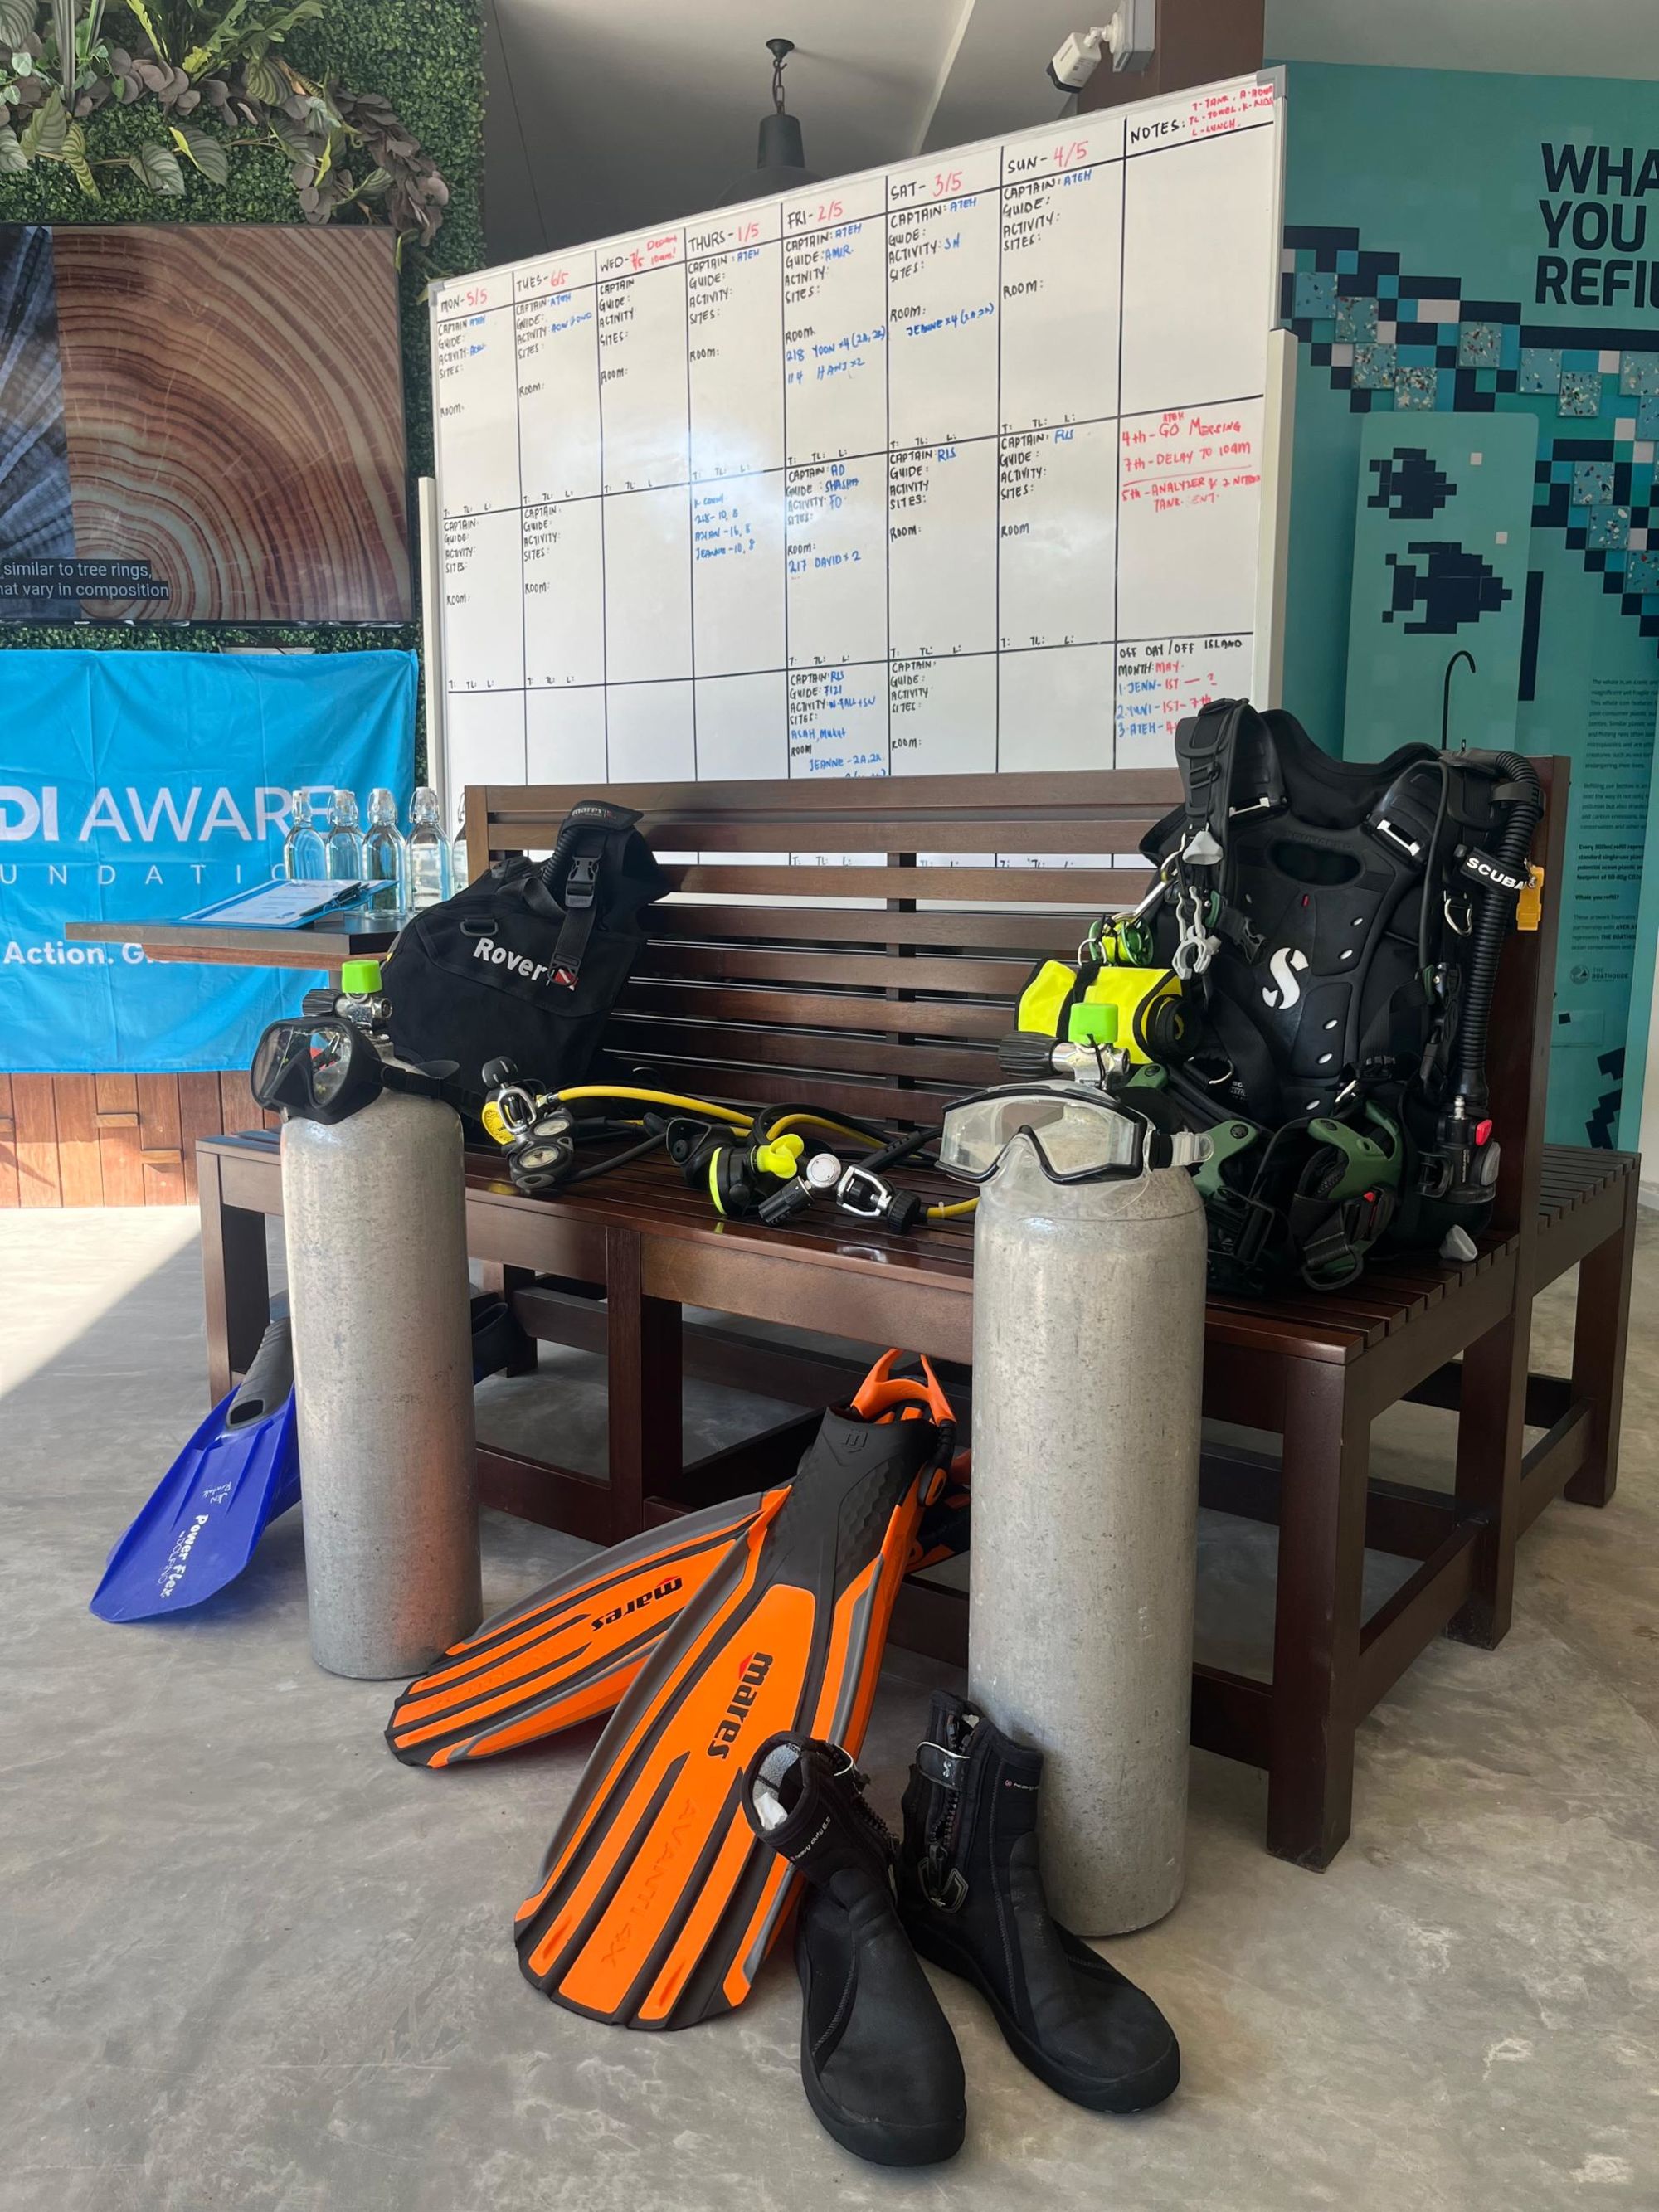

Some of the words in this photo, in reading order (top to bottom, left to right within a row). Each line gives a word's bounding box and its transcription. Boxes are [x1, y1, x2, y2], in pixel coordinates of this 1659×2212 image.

[1131, 119, 1185, 144] NOTES:
[1539, 199, 1647, 252] YOU
[1159, 422, 1180, 438] GO
[1157, 450, 1194, 465] DELAY
[3, 562, 54, 576] similar
[58, 563, 74, 576] to
[77, 563, 107, 576] tree
[111, 562, 152, 580] rings,
[23, 585, 54, 599] vary
[58, 584, 71, 596] in
[75, 583, 169, 599] composition
[3, 941, 114, 965] Action.
[473, 937, 548, 980] Rover
[178, 1514, 209, 1561] Power
[591, 1577, 683, 1631] mares
[708, 1651, 774, 1759] mares
